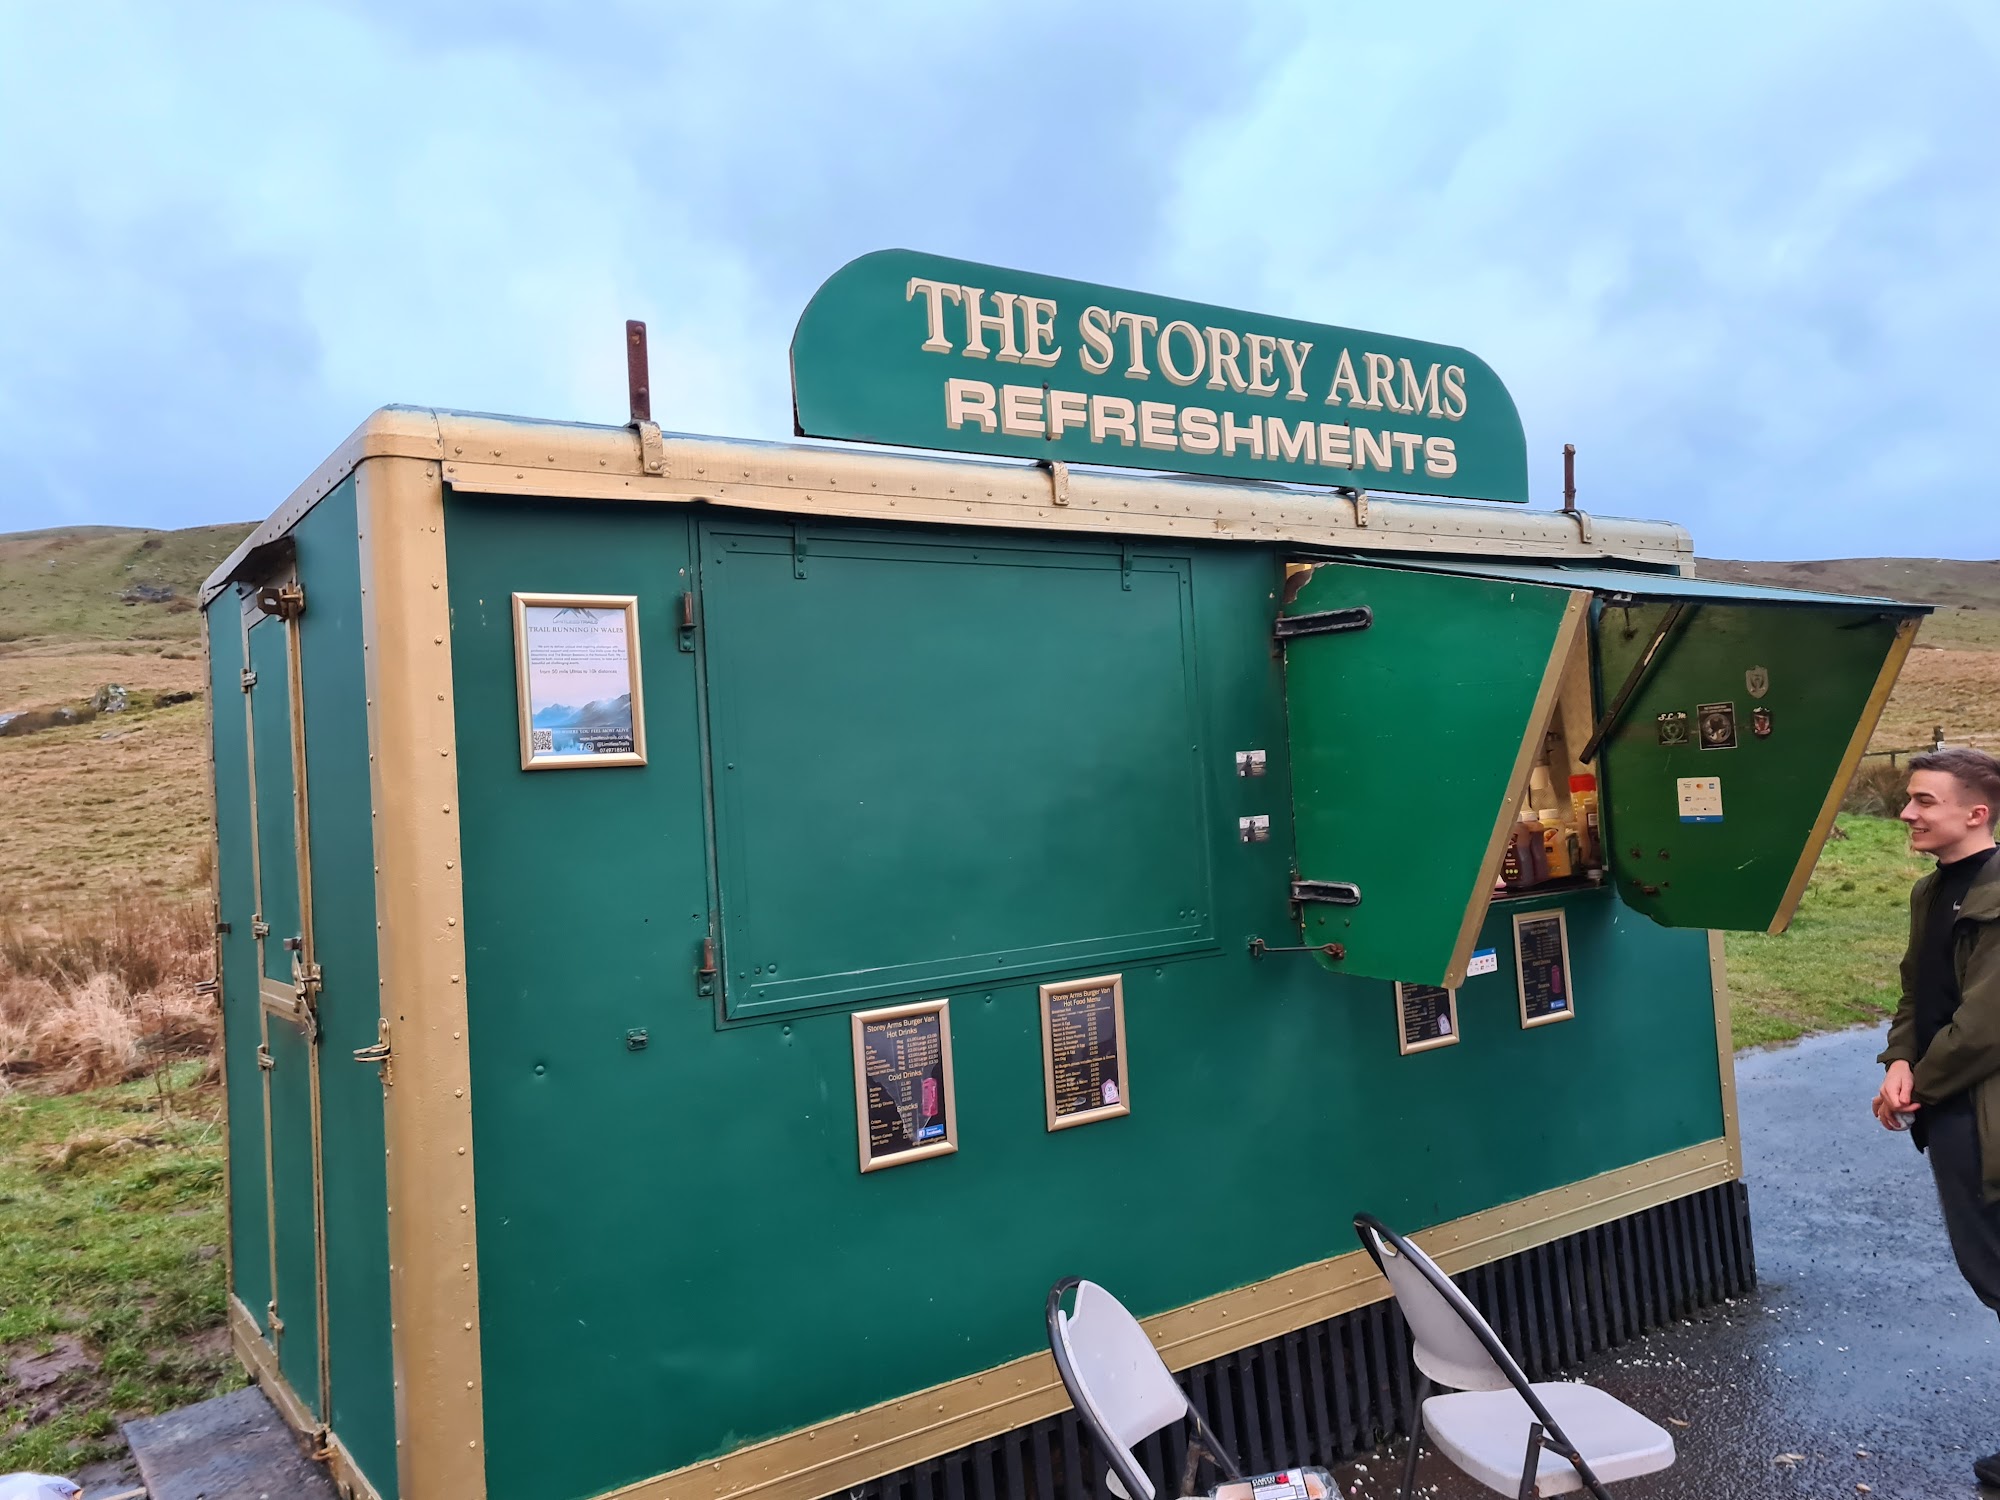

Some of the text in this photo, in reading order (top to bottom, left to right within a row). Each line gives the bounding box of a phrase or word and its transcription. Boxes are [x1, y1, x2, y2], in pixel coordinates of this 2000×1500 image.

[906, 276, 1468, 421] THE STOREY ARMS
[945, 377, 1458, 479] REFRESHMENTS
[903, 1018, 922, 1026] Burger
[898, 1028, 917, 1036] Drinks
[897, 1103, 918, 1112] Snacks
